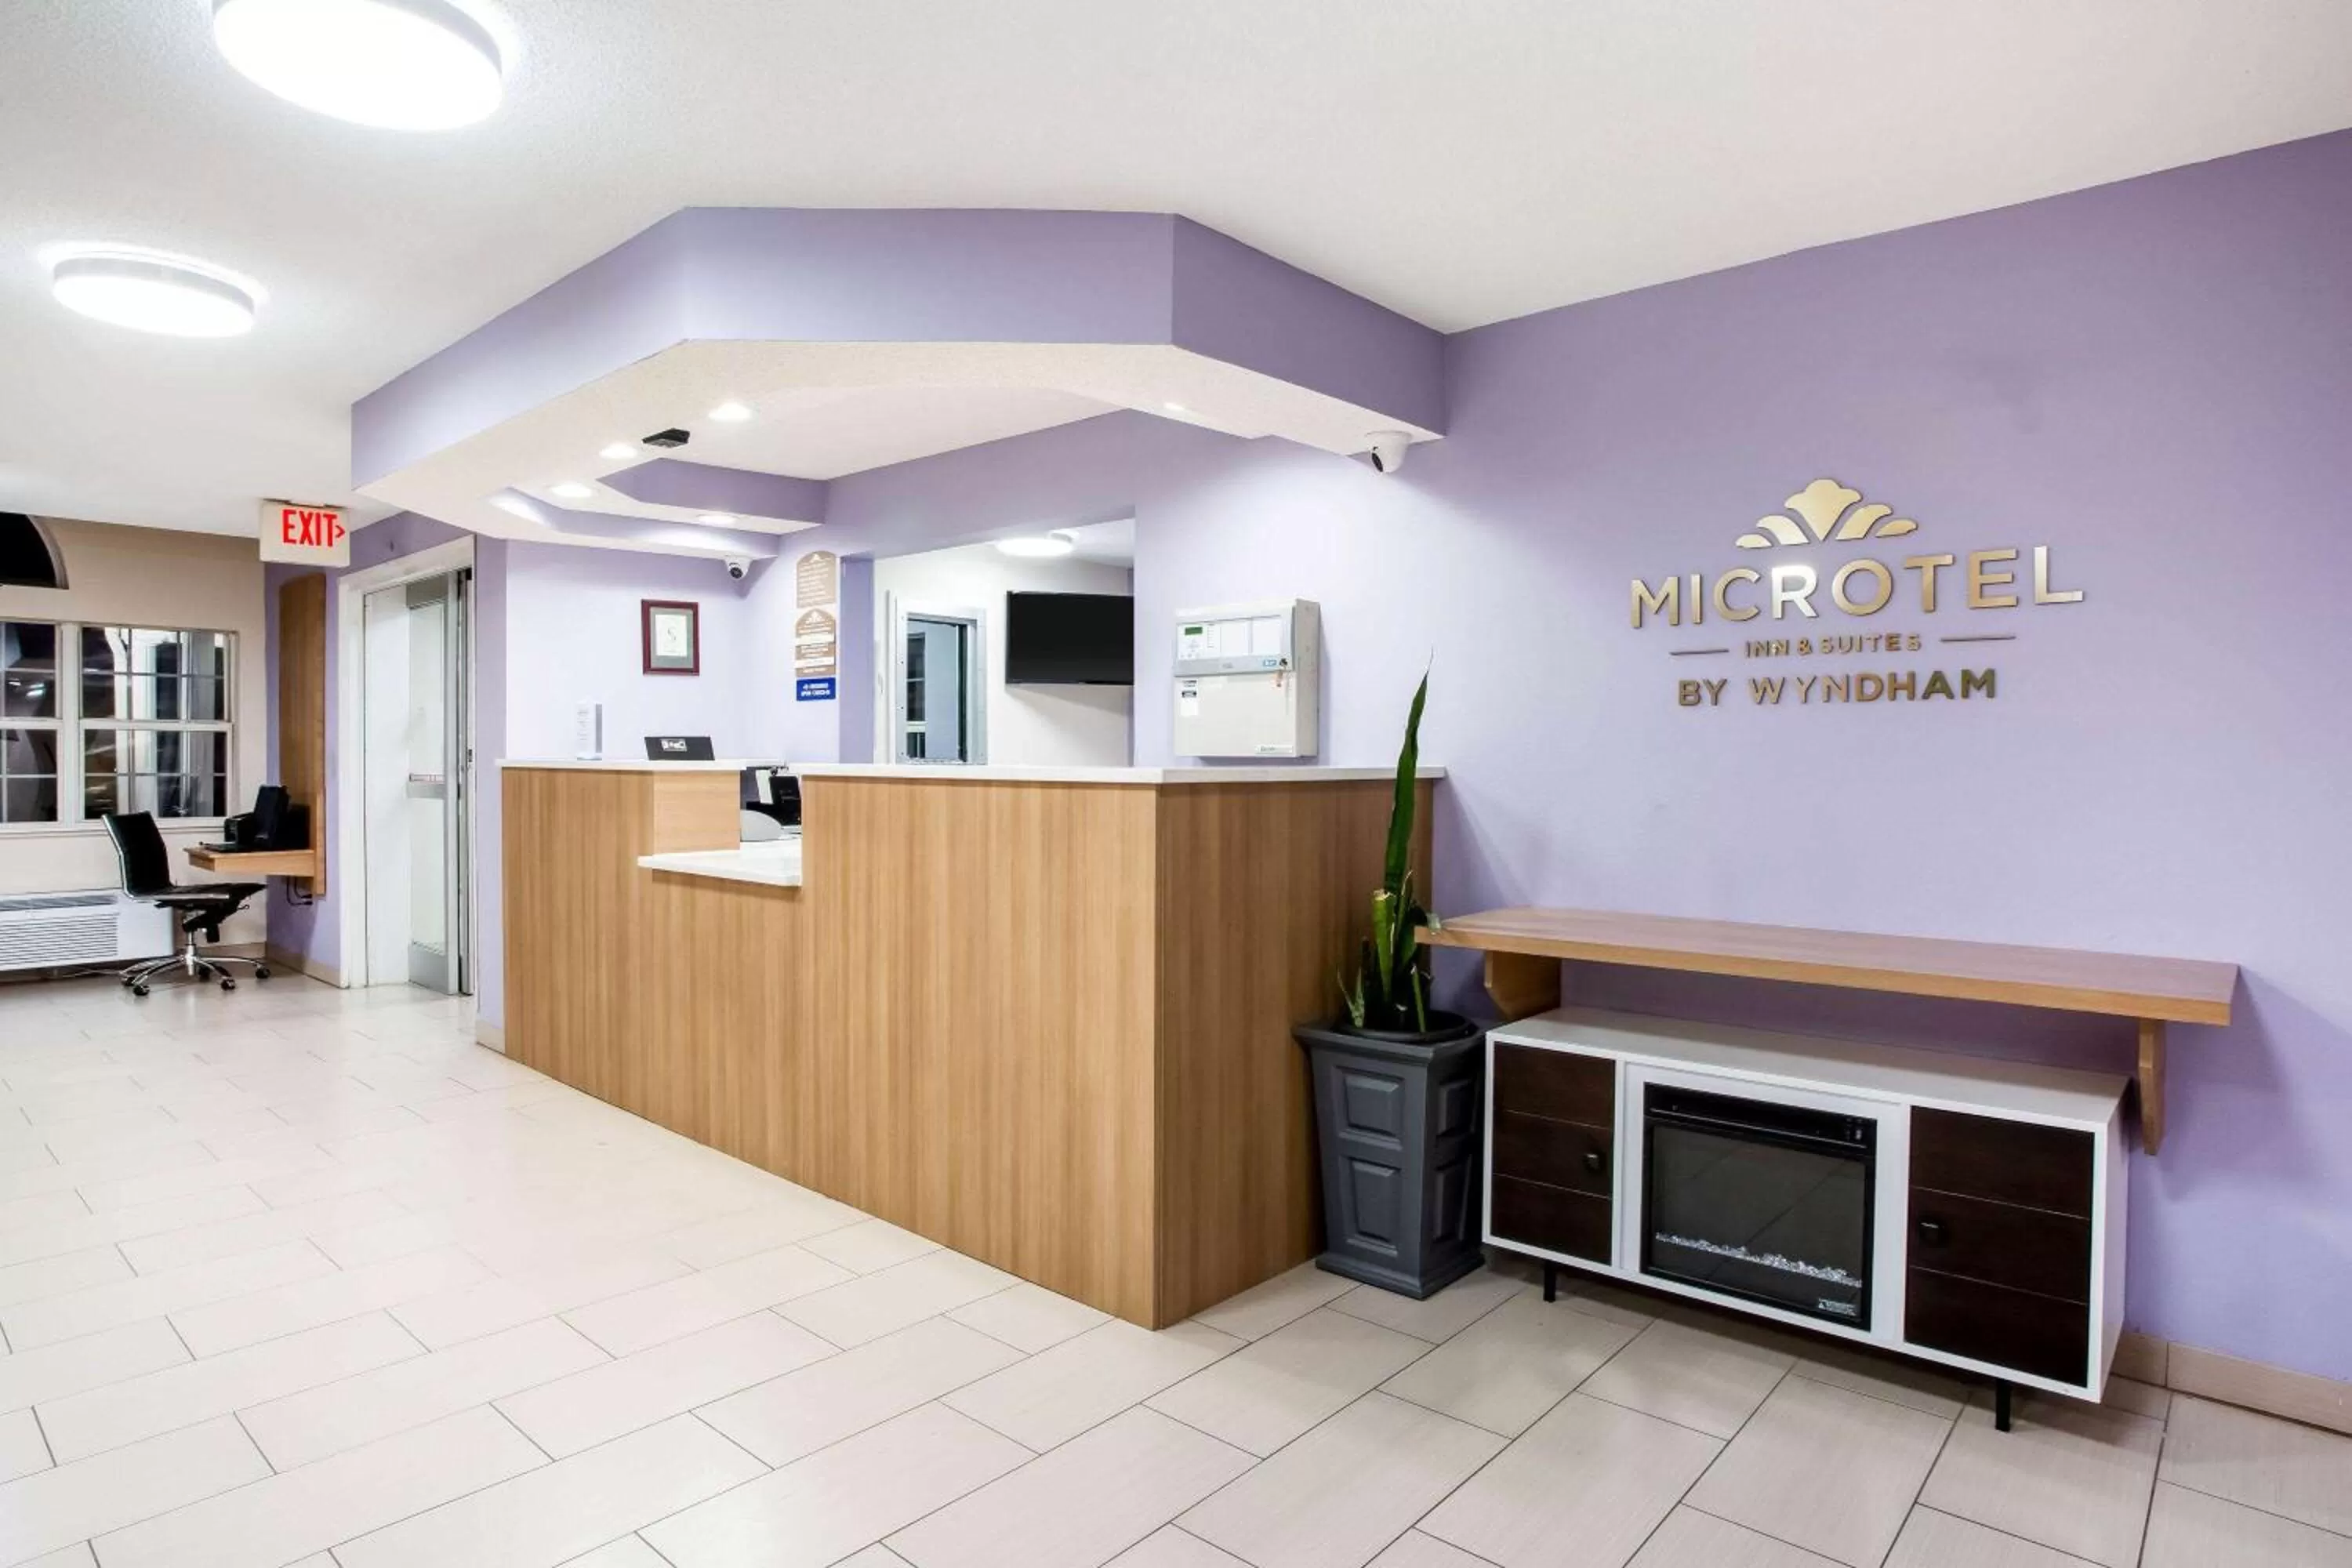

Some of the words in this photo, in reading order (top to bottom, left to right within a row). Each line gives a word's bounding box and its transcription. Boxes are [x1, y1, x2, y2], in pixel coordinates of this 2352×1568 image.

[282, 508, 338, 547] EXIT
[1630, 545, 2084, 629] MICROTEL
[1744, 638, 1791, 659] INN
[1797, 637, 1813, 655] &
[1820, 633, 1922, 654] SUITES
[1678, 678, 1728, 706] BY
[1748, 668, 1996, 705] WYNDHAM
